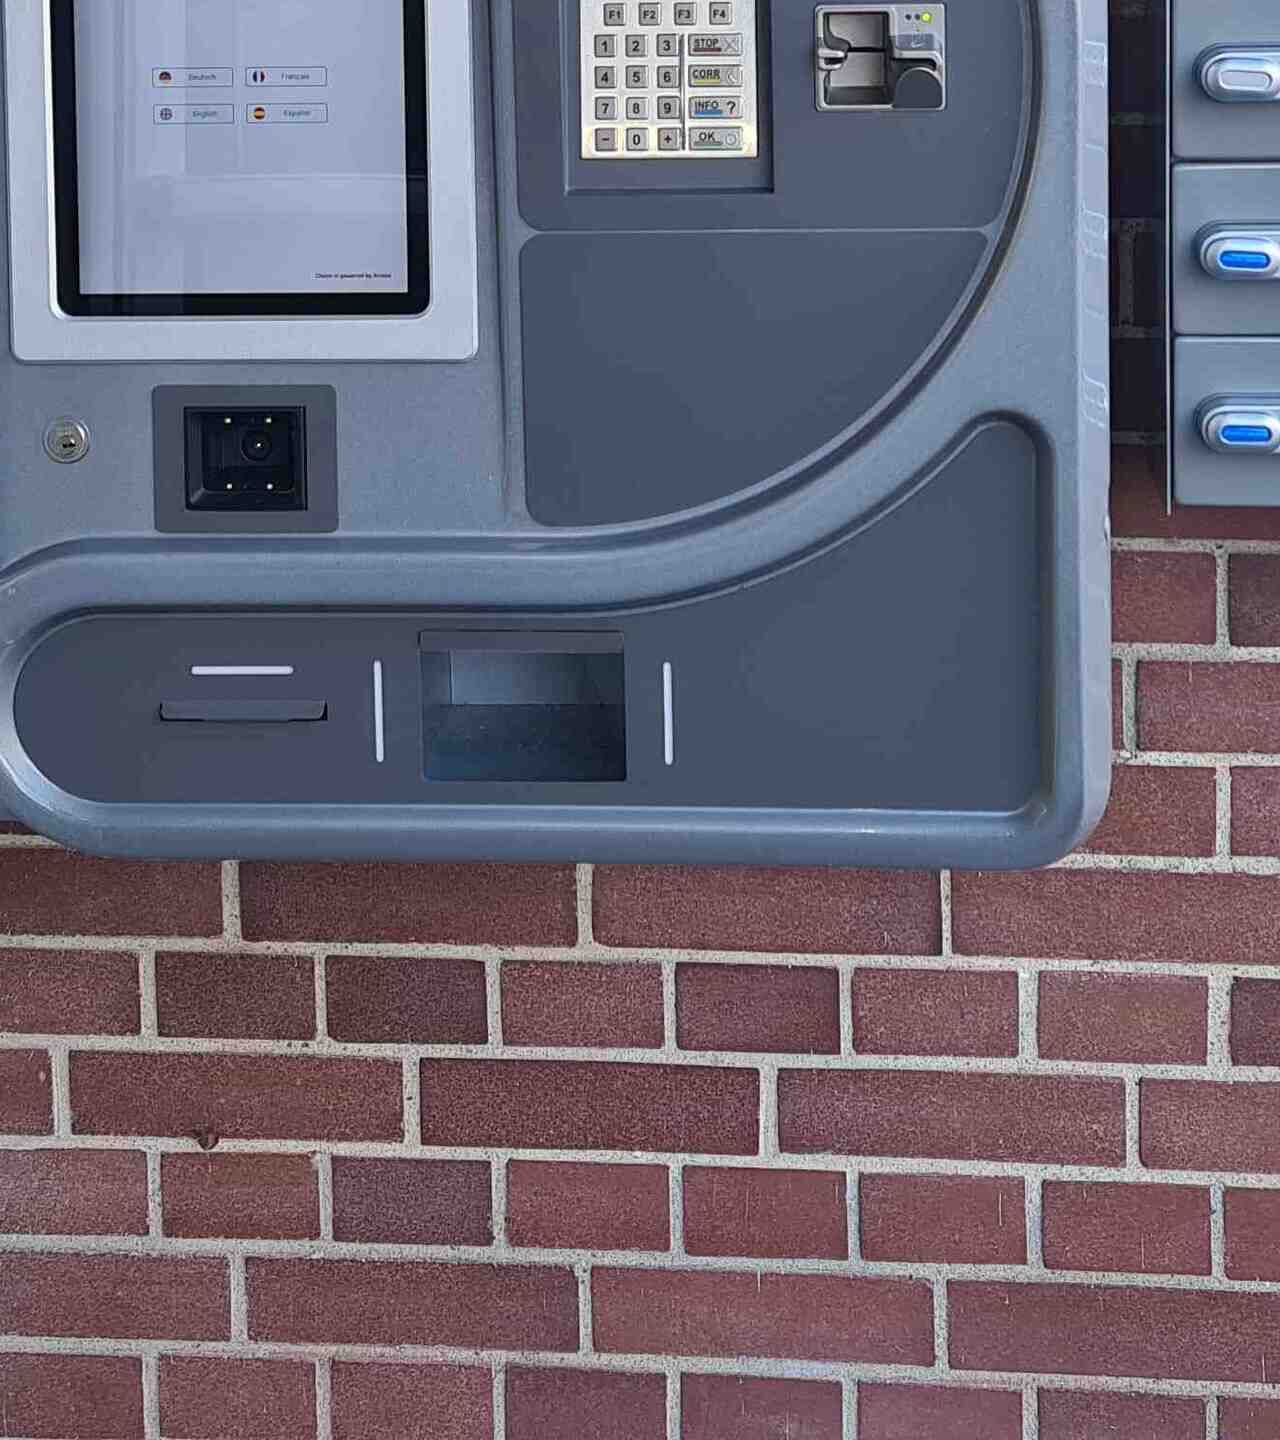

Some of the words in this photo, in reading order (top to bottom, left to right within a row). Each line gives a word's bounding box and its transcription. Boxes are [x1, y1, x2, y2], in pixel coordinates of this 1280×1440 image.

[609, 10, 620, 19] F1
[643, 10, 656, 19] F2
[679, 10, 690, 18] F3
[713, 10, 725, 18] F4
[601, 41, 608, 52] 1
[632, 41, 640, 51] 2
[663, 40, 670, 51] 3
[694, 39, 718, 48] STOP
[601, 72, 608, 82] 4
[633, 72, 640, 83] 5
[663, 72, 671, 82] 6
[693, 69, 720, 79] CORR
[602, 103, 609, 114] 7
[633, 103, 640, 114] 8
[664, 103, 671, 113] 9
[695, 101, 719, 110] INFO
[633, 134, 640, 145] 0
[699, 132, 715, 142] OK
